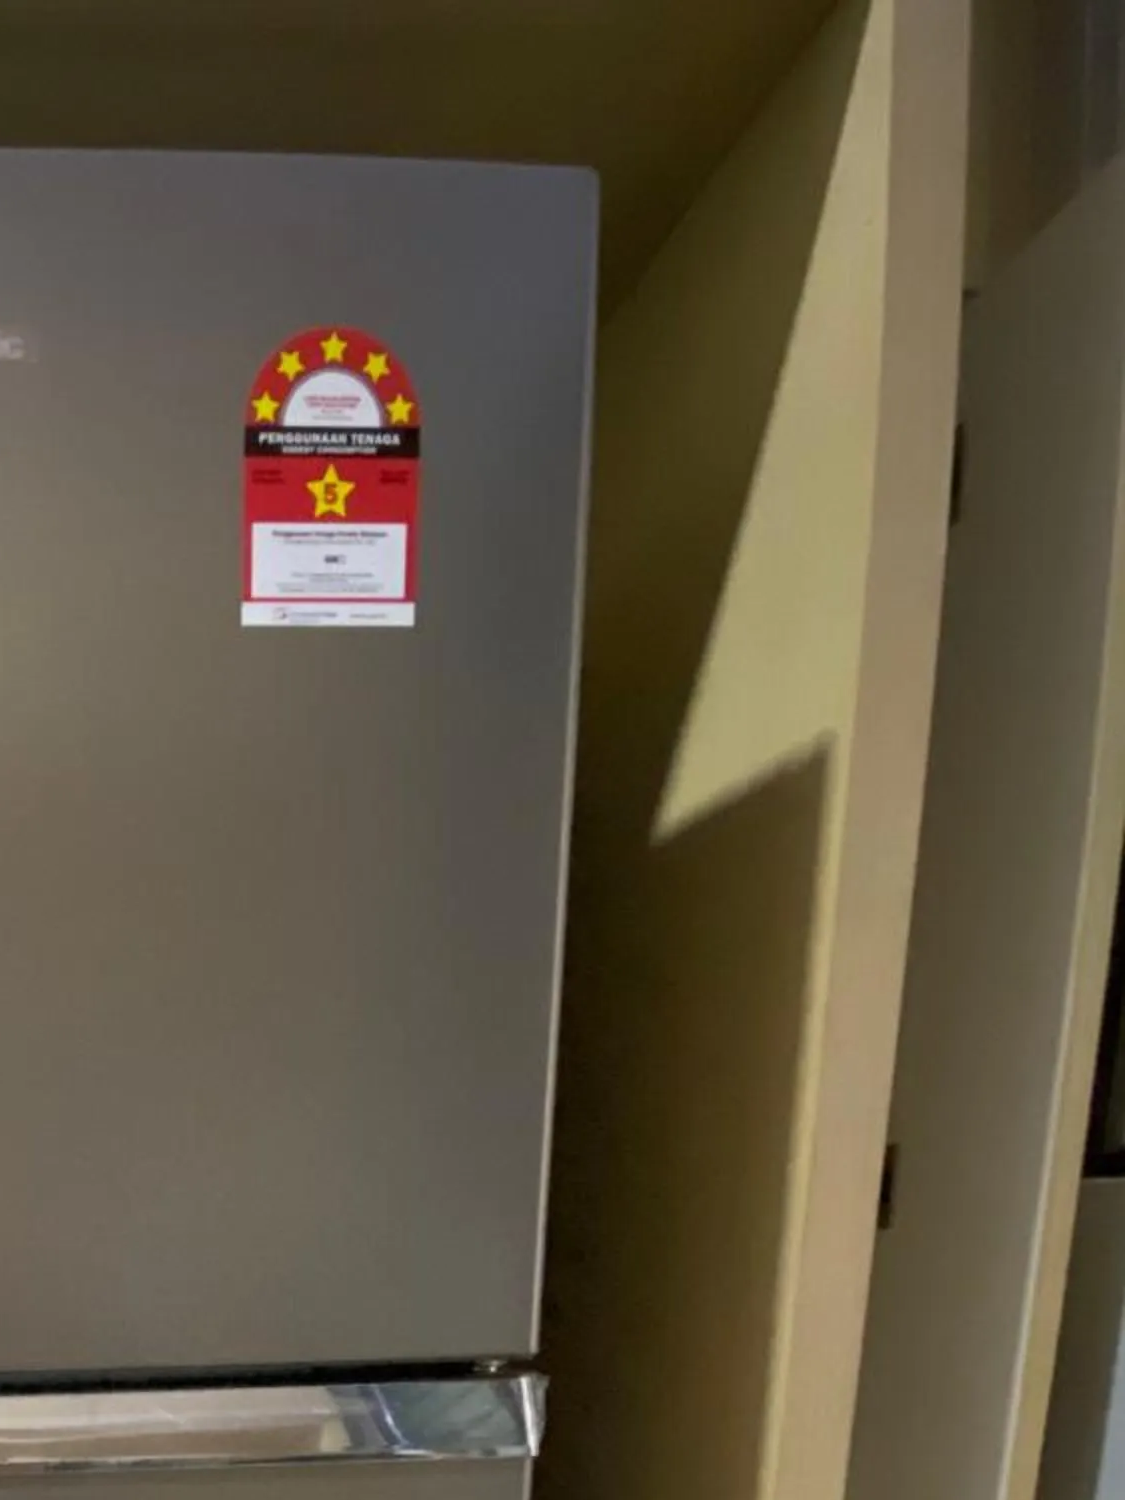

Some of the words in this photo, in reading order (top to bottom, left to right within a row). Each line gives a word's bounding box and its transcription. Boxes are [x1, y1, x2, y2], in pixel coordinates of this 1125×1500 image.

[258, 431, 347, 445] PENGGUNAAN
[350, 432, 401, 446] TENAGA
[324, 483, 338, 505] 5
